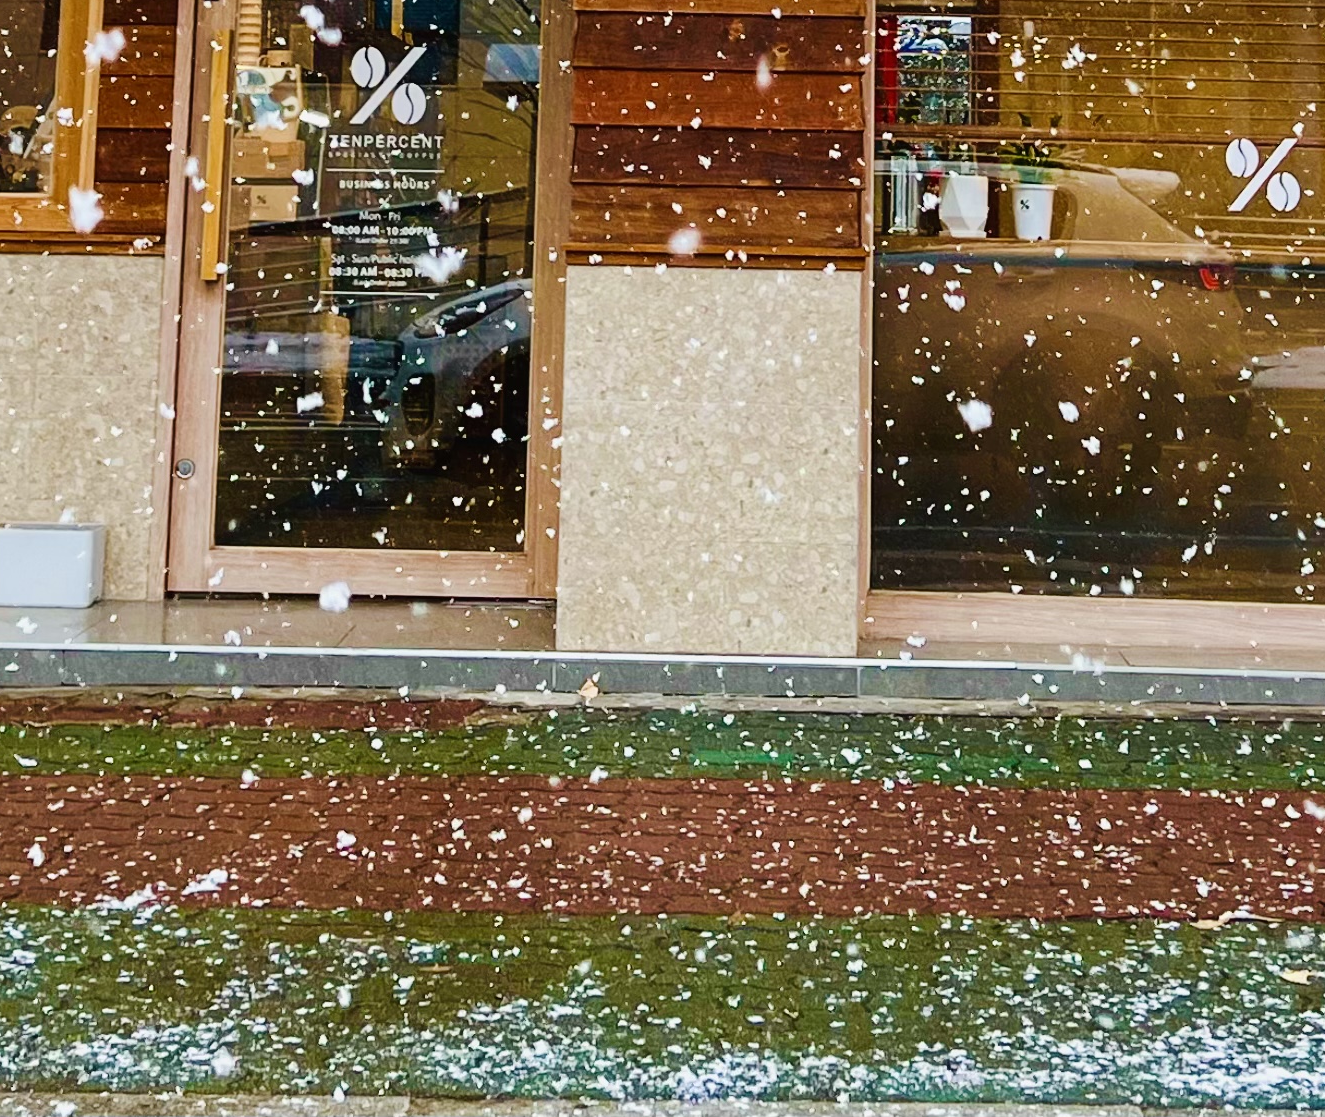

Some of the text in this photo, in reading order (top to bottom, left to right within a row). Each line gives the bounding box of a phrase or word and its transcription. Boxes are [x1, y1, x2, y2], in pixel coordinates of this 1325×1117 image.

[328, 133, 445, 149] TENPERCENT
[339, 179, 430, 190] BUSINS HOURS
[359, 211, 381, 221] Mon
[388, 211, 402, 221] Fri
[362, 225, 380, 235] AM
[360, 265, 378, 277] AM
